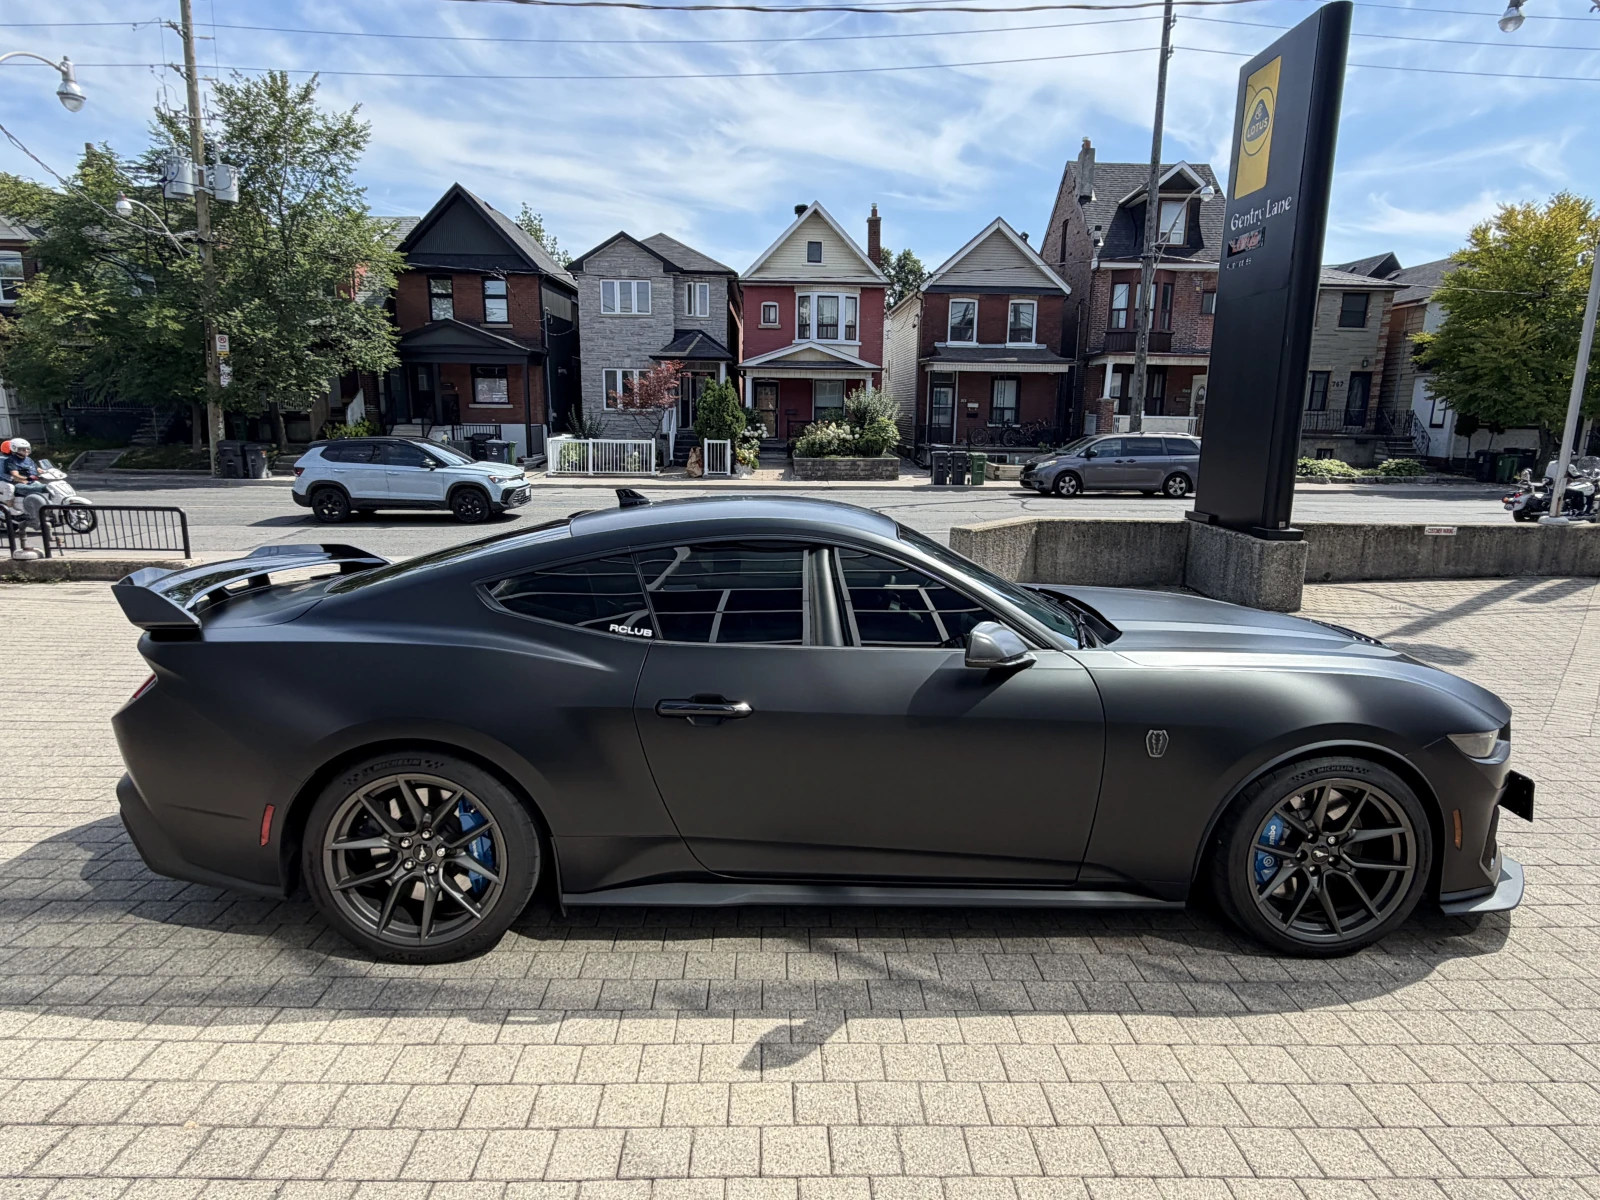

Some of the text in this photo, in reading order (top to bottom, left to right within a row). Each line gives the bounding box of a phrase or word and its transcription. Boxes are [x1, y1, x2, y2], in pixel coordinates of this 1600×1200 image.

[1247, 117, 1268, 138] LOTUS
[1230, 196, 1292, 231] Gentry Lane
[609, 623, 653, 637] RCLUB
[374, 759, 421, 772] MICHELIN
[1317, 765, 1353, 773] MICHELIN
